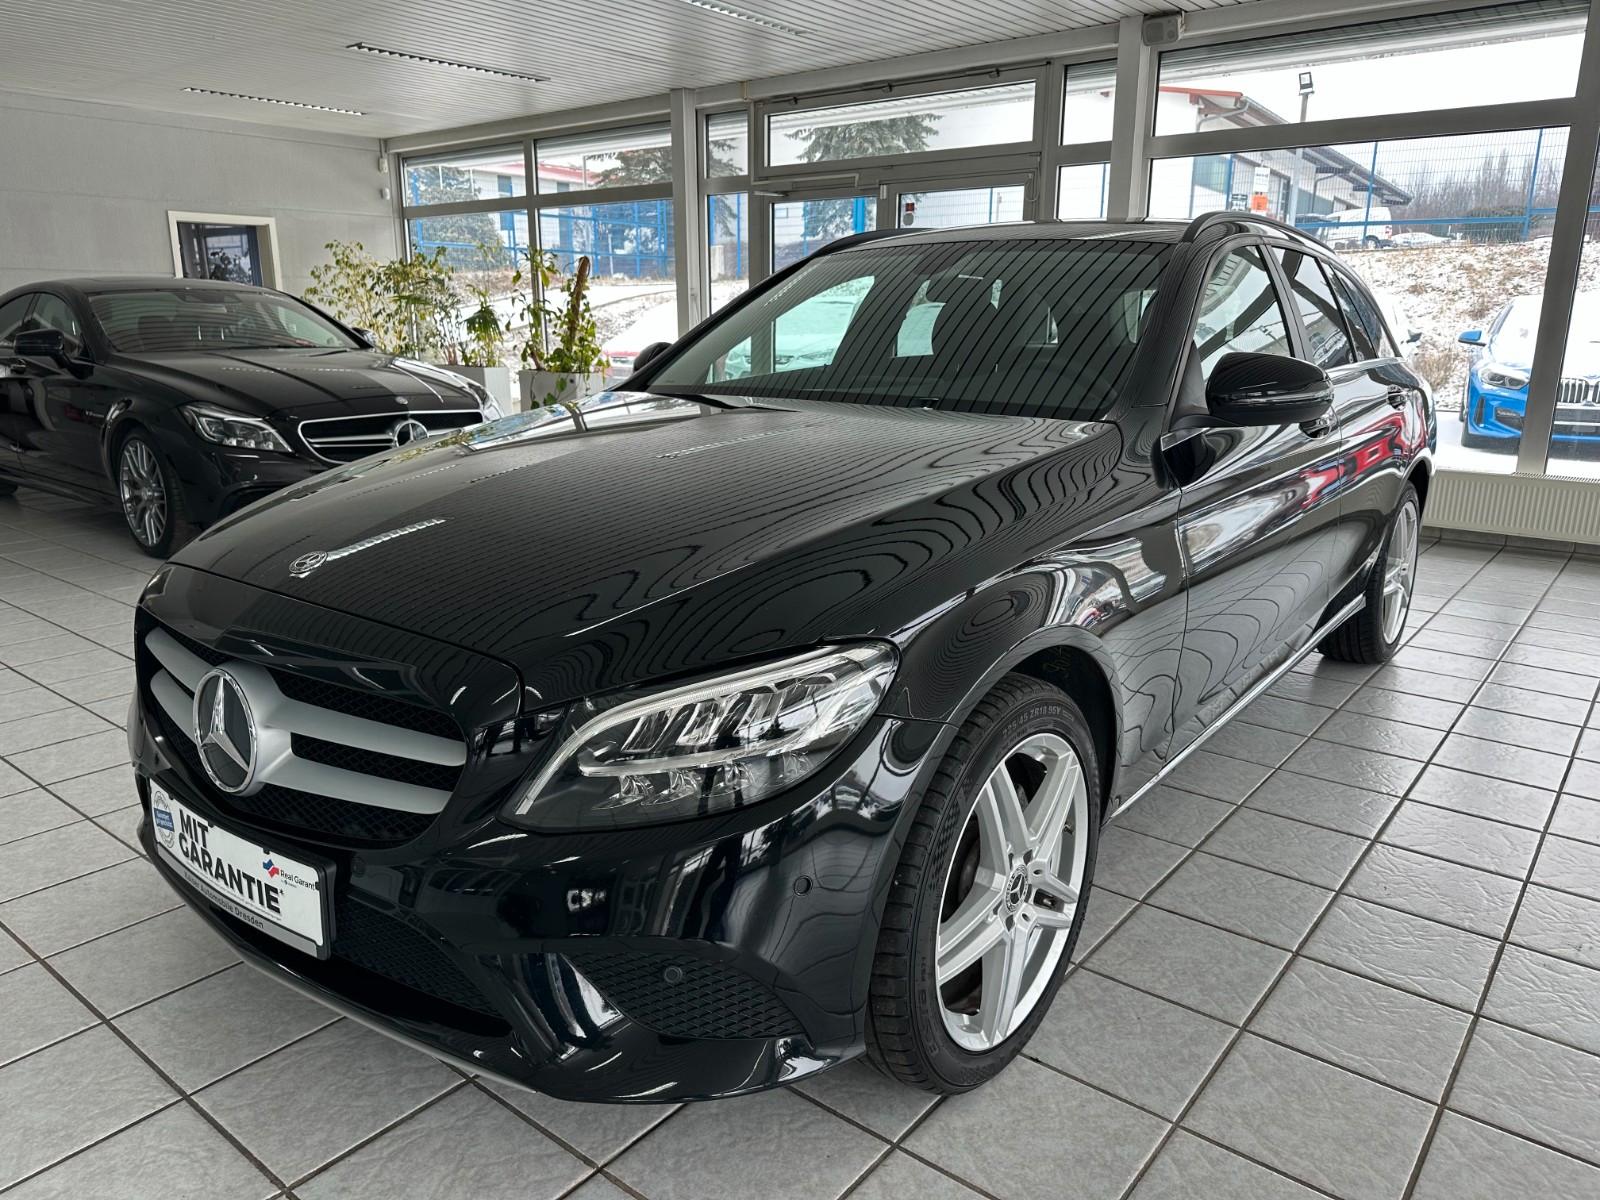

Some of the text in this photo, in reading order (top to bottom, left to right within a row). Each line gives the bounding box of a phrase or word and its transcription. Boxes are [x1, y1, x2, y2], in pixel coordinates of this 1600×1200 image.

[179, 808, 209, 848] MIT
[280, 869, 294, 882] Real
[200, 885, 234, 913] Automobile
[234, 905, 264, 929] Dresden
